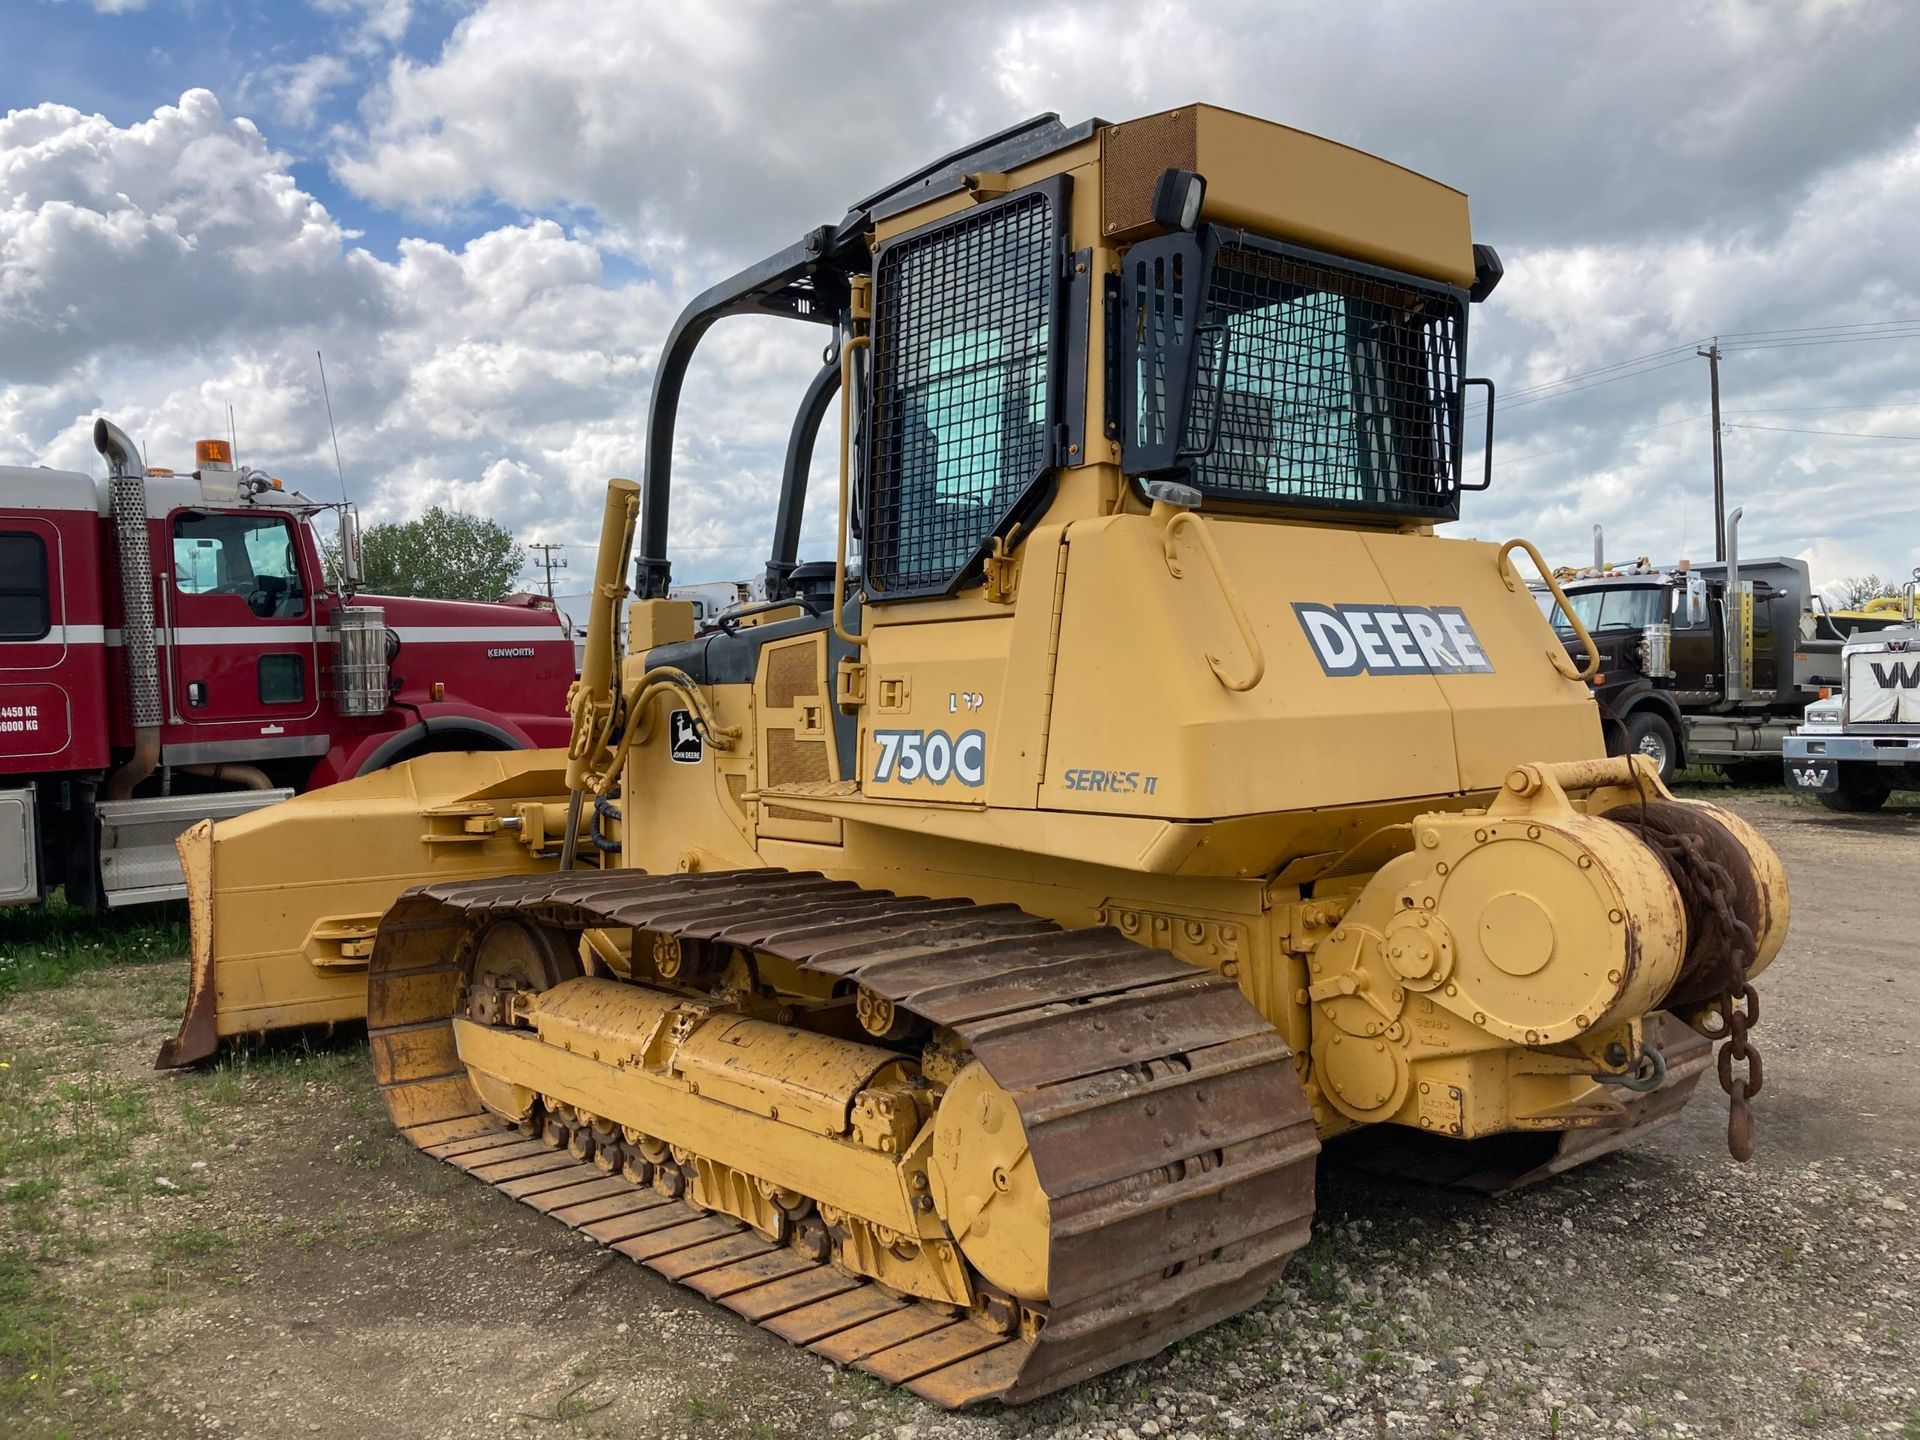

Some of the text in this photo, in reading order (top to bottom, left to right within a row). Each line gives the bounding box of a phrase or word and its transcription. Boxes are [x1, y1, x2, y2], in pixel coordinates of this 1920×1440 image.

[1300, 609, 1487, 669] DEERE
[487, 647, 535, 657] KENWORTH
[0, 705, 37, 717] 4450 KG
[26, 720, 38, 731] KG
[673, 751, 701, 759] JOHN DEERE
[874, 733, 983, 783] 750C
[1063, 768, 1140, 793] SERIES
